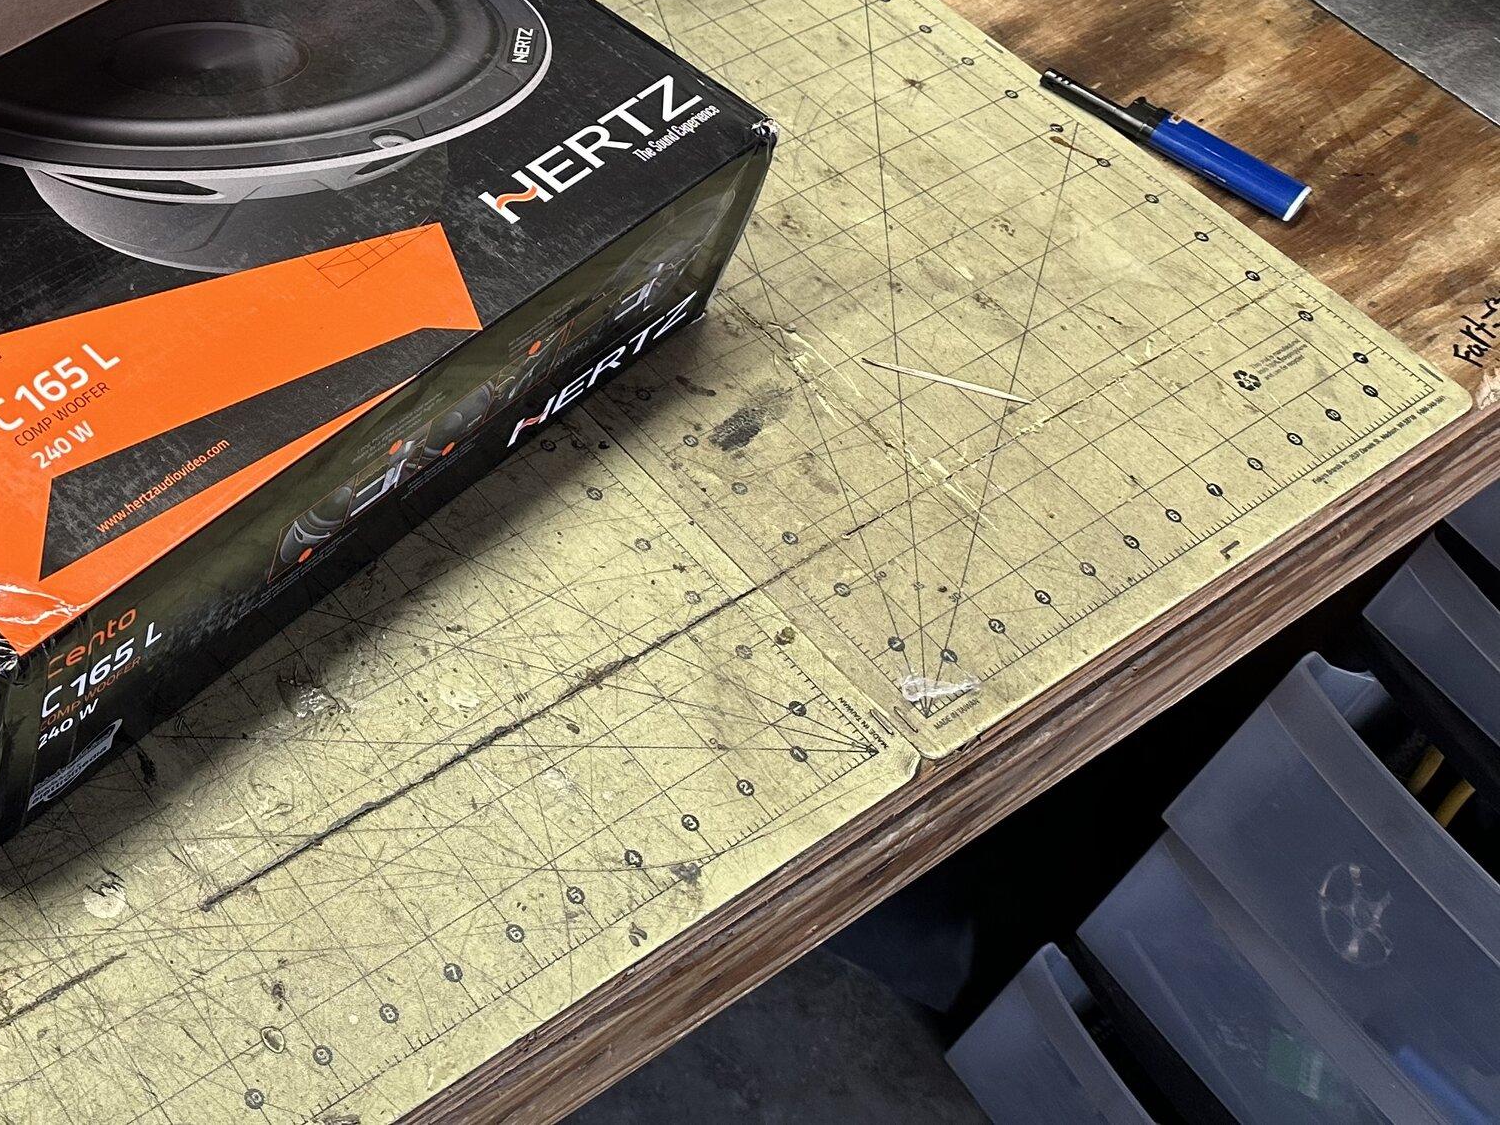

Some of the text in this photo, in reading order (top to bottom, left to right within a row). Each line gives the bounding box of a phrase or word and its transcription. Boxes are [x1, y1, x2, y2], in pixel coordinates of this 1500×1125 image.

[511, 27, 534, 64] HERTZ
[477, 74, 703, 225] HERTZ
[632, 104, 721, 163] The Sound Experience
[13, 356, 90, 412] 165
[81, 342, 121, 371] L
[506, 290, 698, 448] HERTZ
[13, 381, 111, 448] COMP WOOFER
[31, 419, 96, 469] 240 W
[96, 437, 230, 535] www.hertzaudiovideo.com
[41, 621, 162, 719] C 165 L
[48, 608, 137, 679] Cento
[38, 697, 99, 751] 240 W
[40, 655, 143, 733] COMP WOOFER
[837, 697, 889, 749] MADE TAIWAN
[933, 698, 980, 730] MADE TAIWAN
